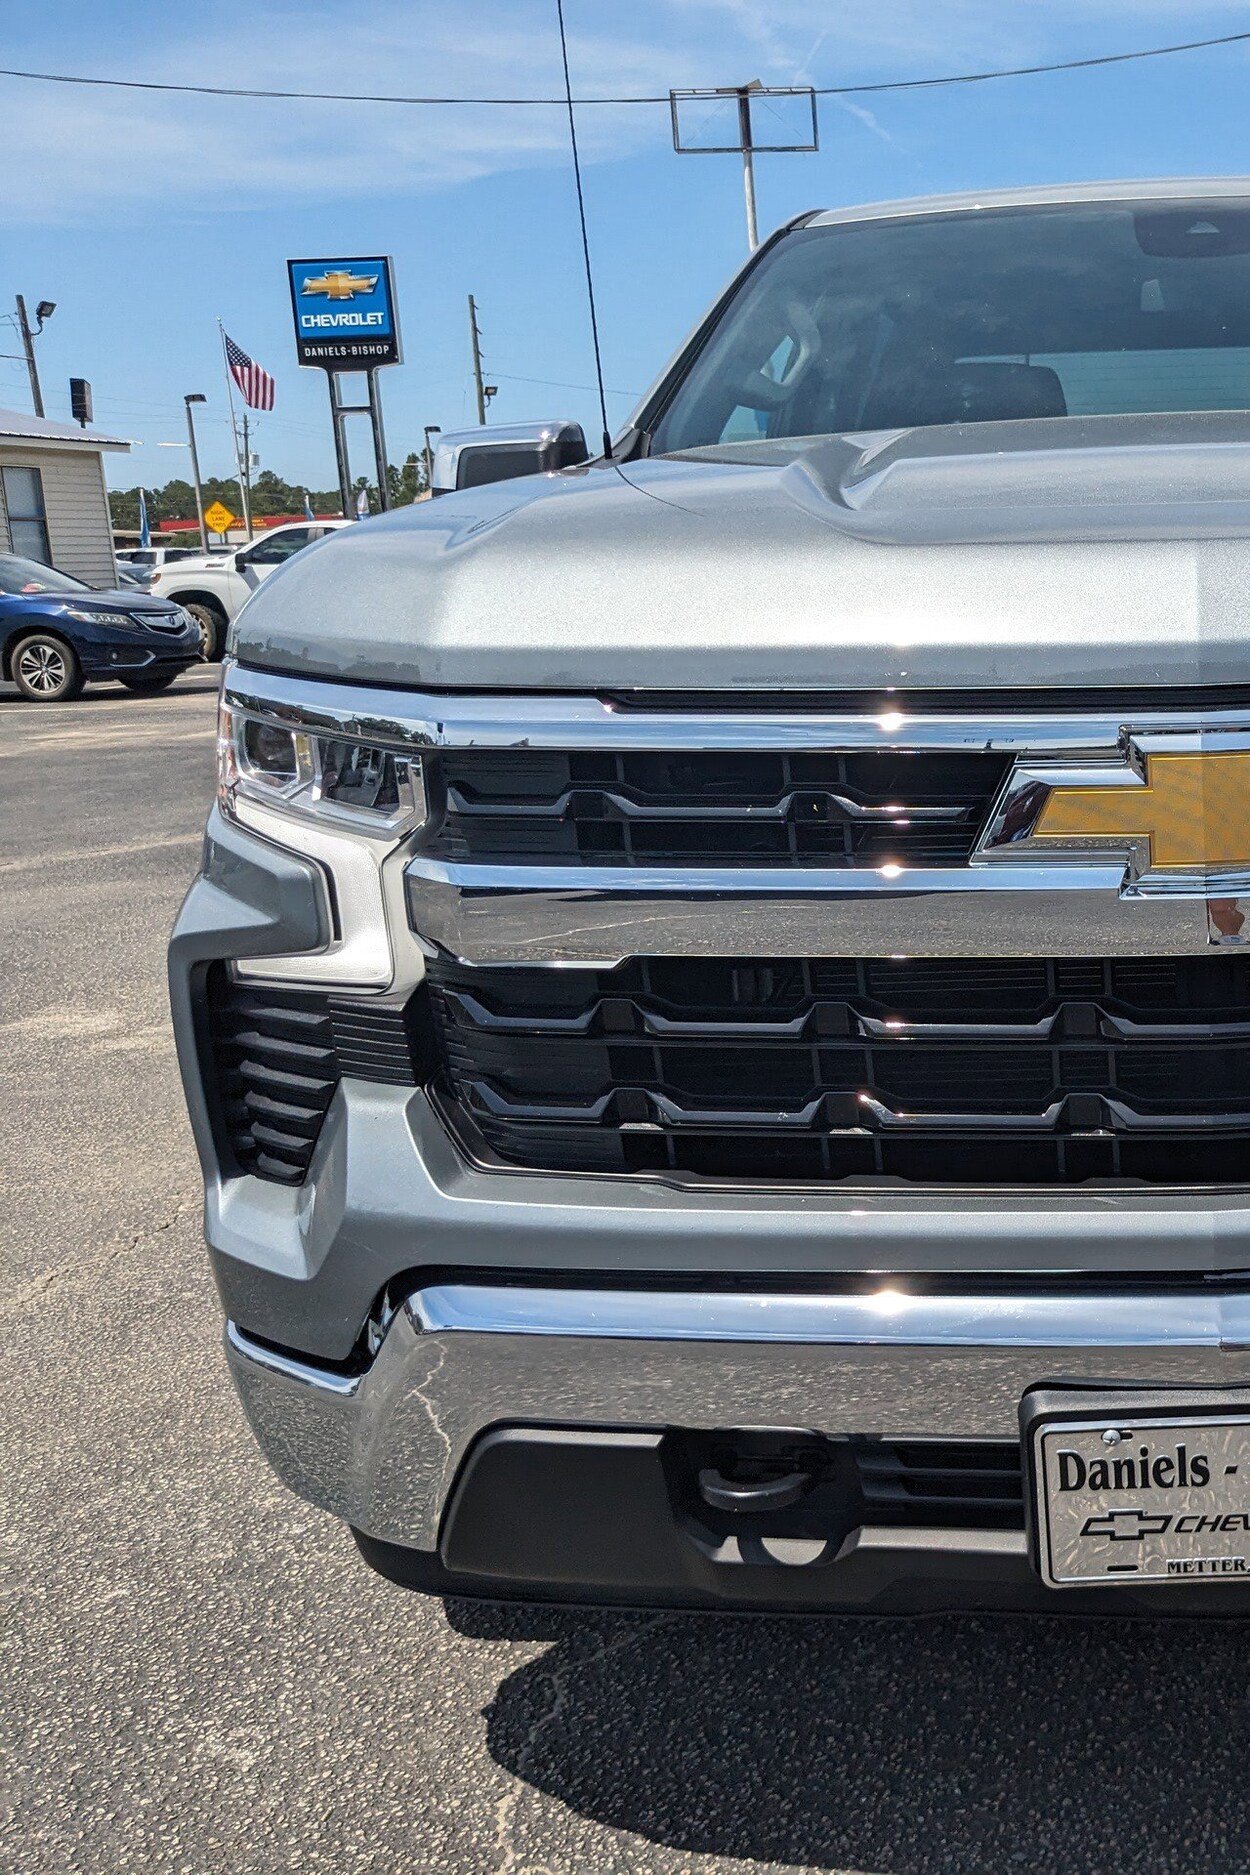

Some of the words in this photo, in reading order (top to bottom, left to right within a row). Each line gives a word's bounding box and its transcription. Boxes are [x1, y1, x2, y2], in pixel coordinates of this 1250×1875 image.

[301, 312, 384, 327] CHEVROLET
[304, 345, 389, 357] DANIELS-BISHOP
[1056, 1443, 1211, 1492] Daniels
